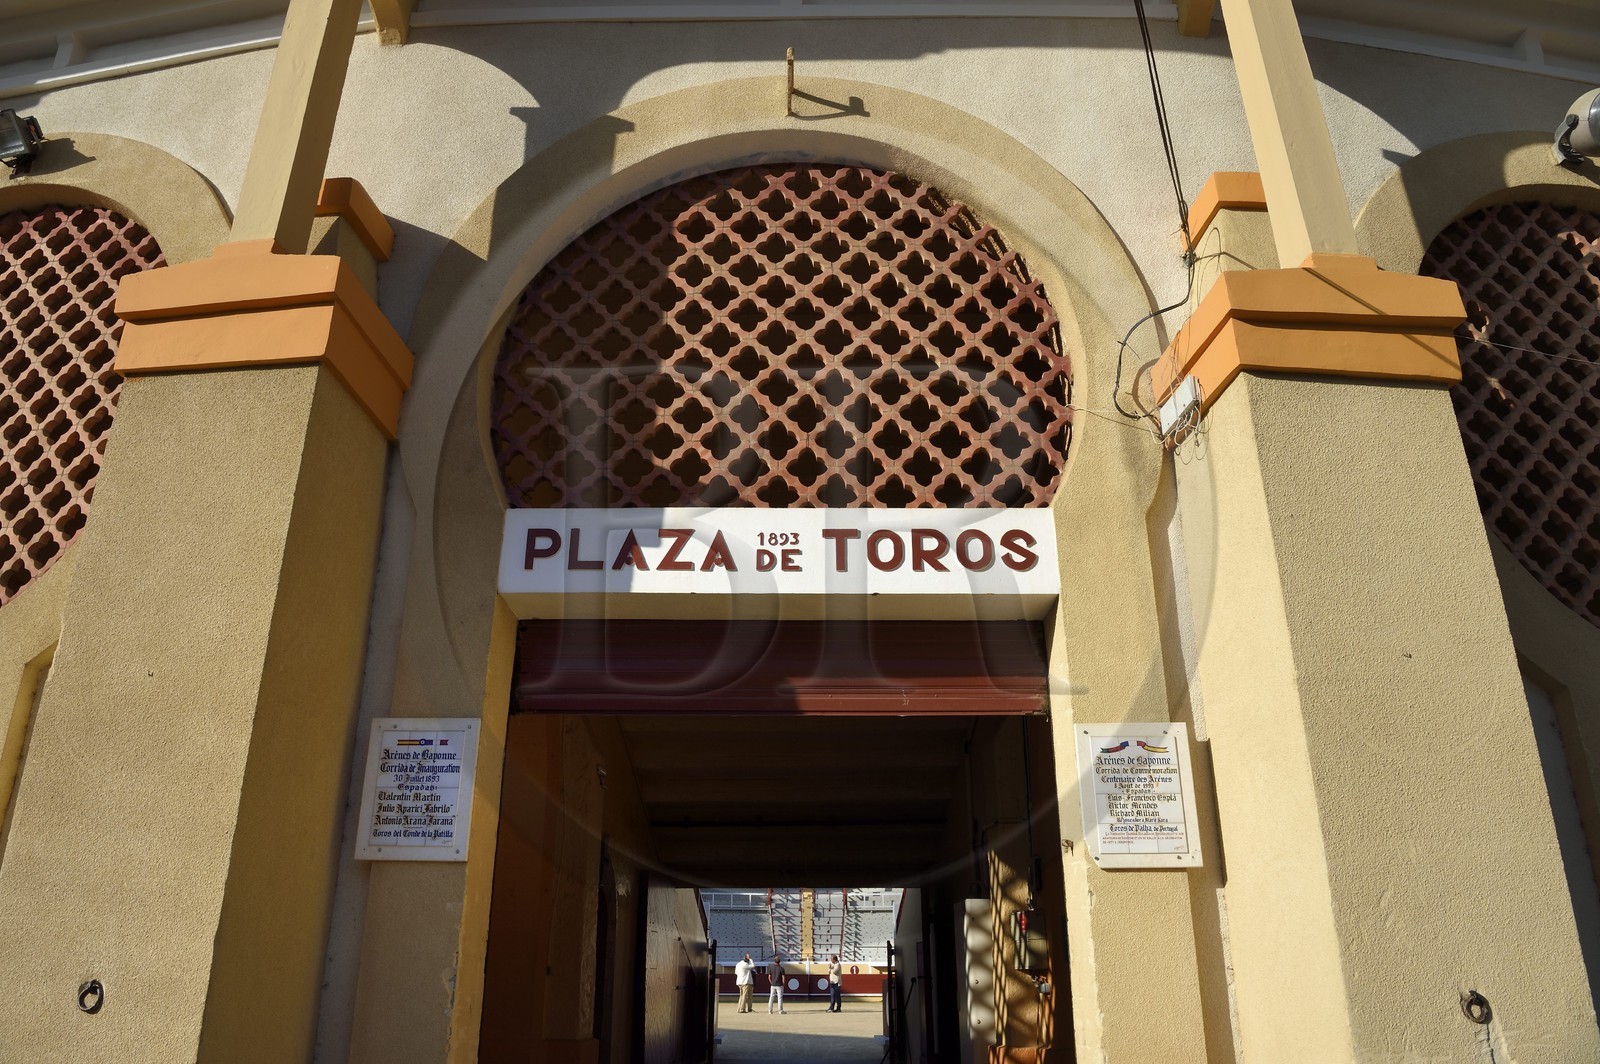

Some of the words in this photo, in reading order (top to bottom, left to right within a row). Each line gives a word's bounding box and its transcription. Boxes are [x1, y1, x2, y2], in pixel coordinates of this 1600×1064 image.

[757, 532, 800, 546] 1893
[524, 527, 739, 571] PLAZA
[756, 548, 803, 572] DE
[822, 527, 1040, 572] TOROS
[413, 751, 420, 759] de
[421, 749, 456, 762] Bayonne
[1136, 756, 1170, 768] Bayonne
[380, 762, 408, 773] Corrida
[409, 765, 416, 773] de
[416, 762, 460, 774] Inauguration
[394, 774, 402, 782] 30
[404, 774, 424, 782] Juillet
[378, 791, 411, 801] Valentin
[412, 792, 441, 802] Martin
[377, 803, 395, 813] Julio
[396, 804, 422, 814] Aparici
[375, 815, 402, 825] Antonio
[402, 816, 426, 826] Arana
[373, 829, 391, 837] Toros
[433, 830, 452, 840] Patilla
[852, 966, 857, 974] 1
